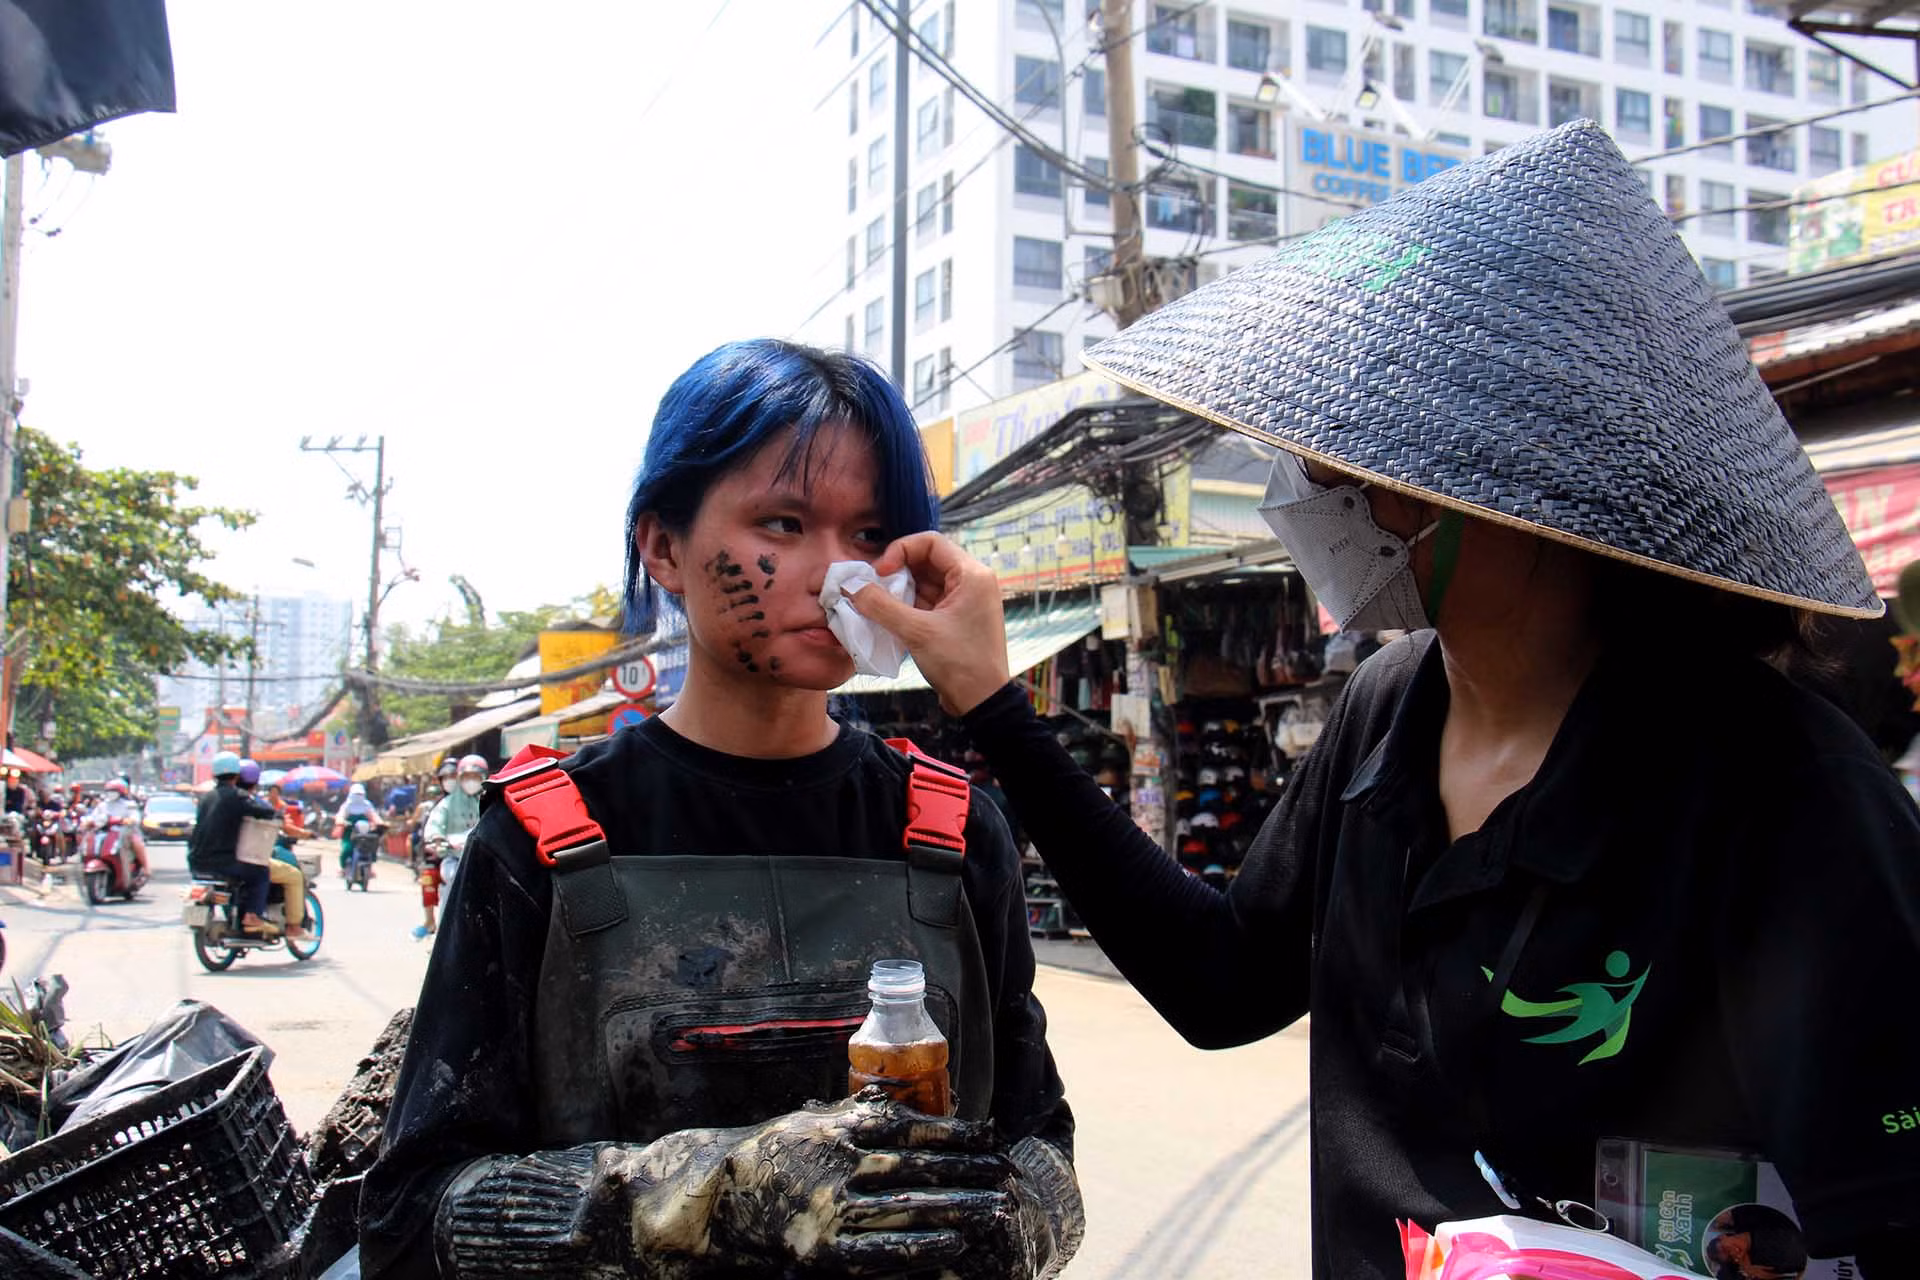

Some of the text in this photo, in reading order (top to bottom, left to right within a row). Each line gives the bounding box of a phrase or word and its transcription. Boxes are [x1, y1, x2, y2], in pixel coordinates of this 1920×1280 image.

[1302, 127, 1462, 184] BLUE BE
[1881, 1106, 1920, 1134] Sài
[1832, 1260, 1854, 1280] ÚY
